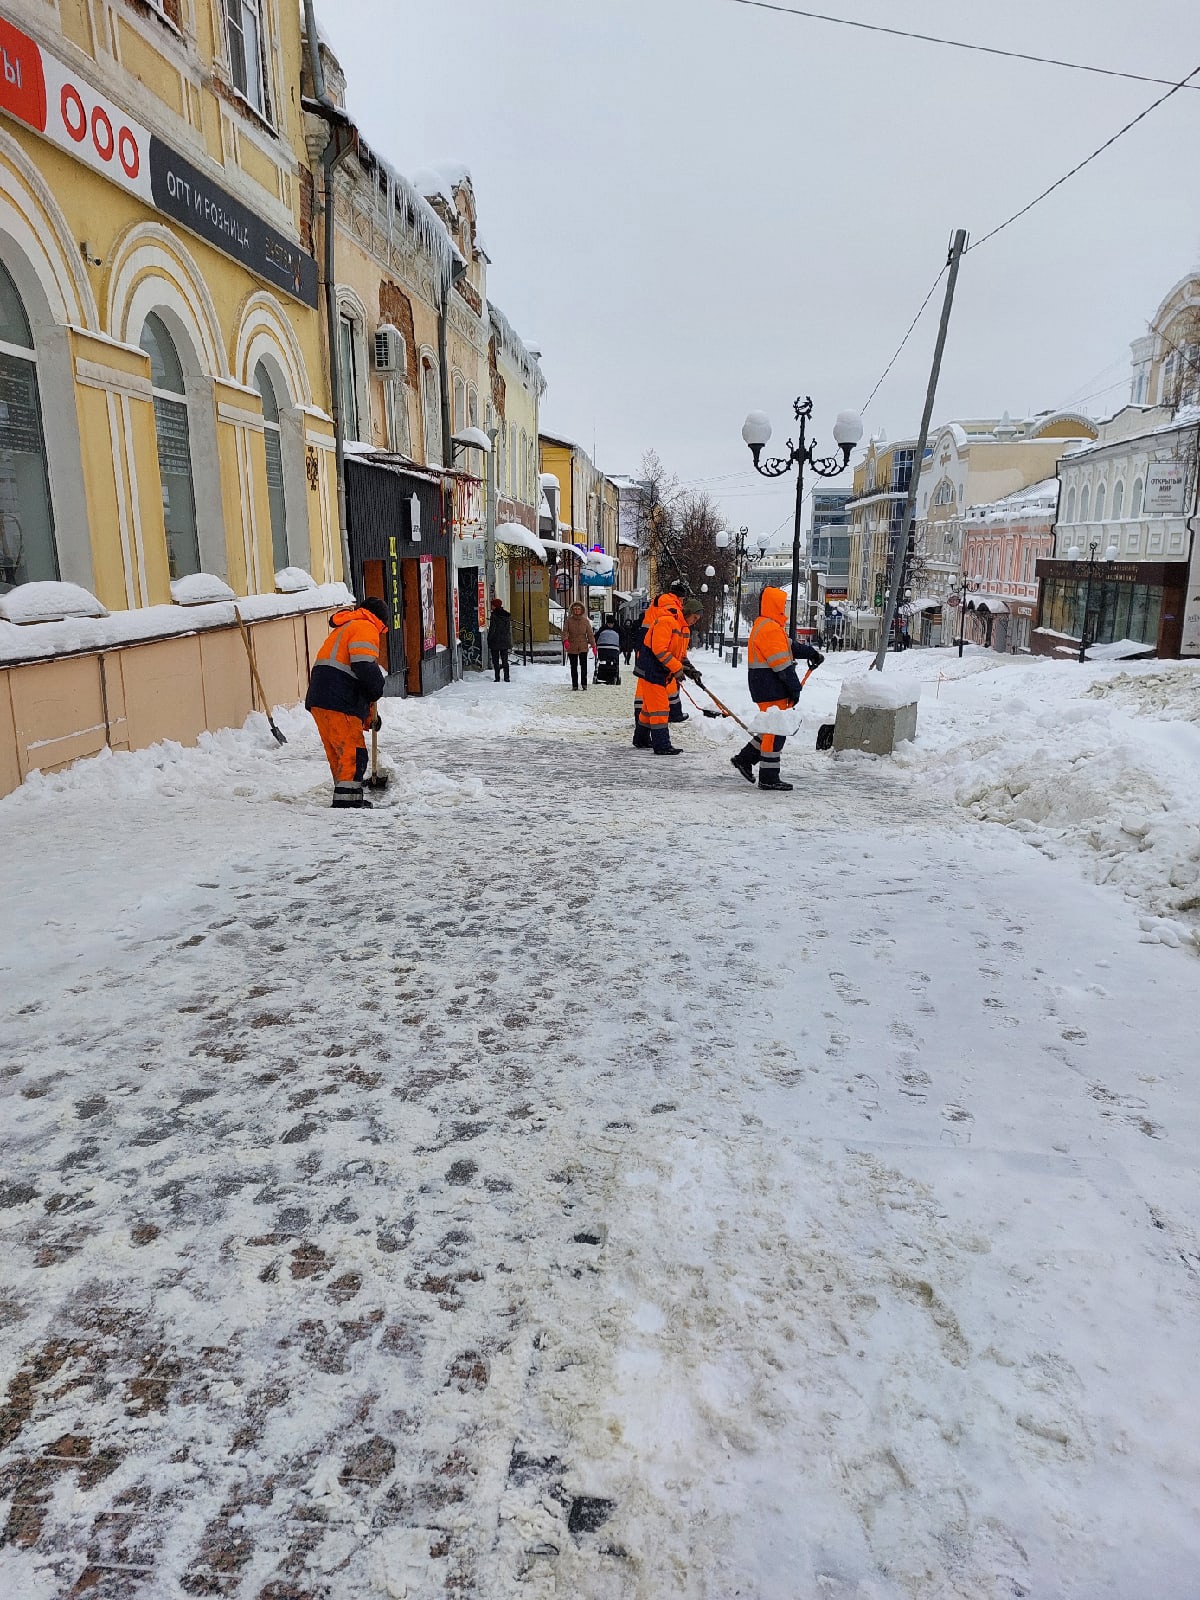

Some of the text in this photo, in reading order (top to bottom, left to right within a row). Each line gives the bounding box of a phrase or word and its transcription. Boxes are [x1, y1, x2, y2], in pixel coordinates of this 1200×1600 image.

[166, 170, 250, 249] ОПТ И РОЗНИЦА
